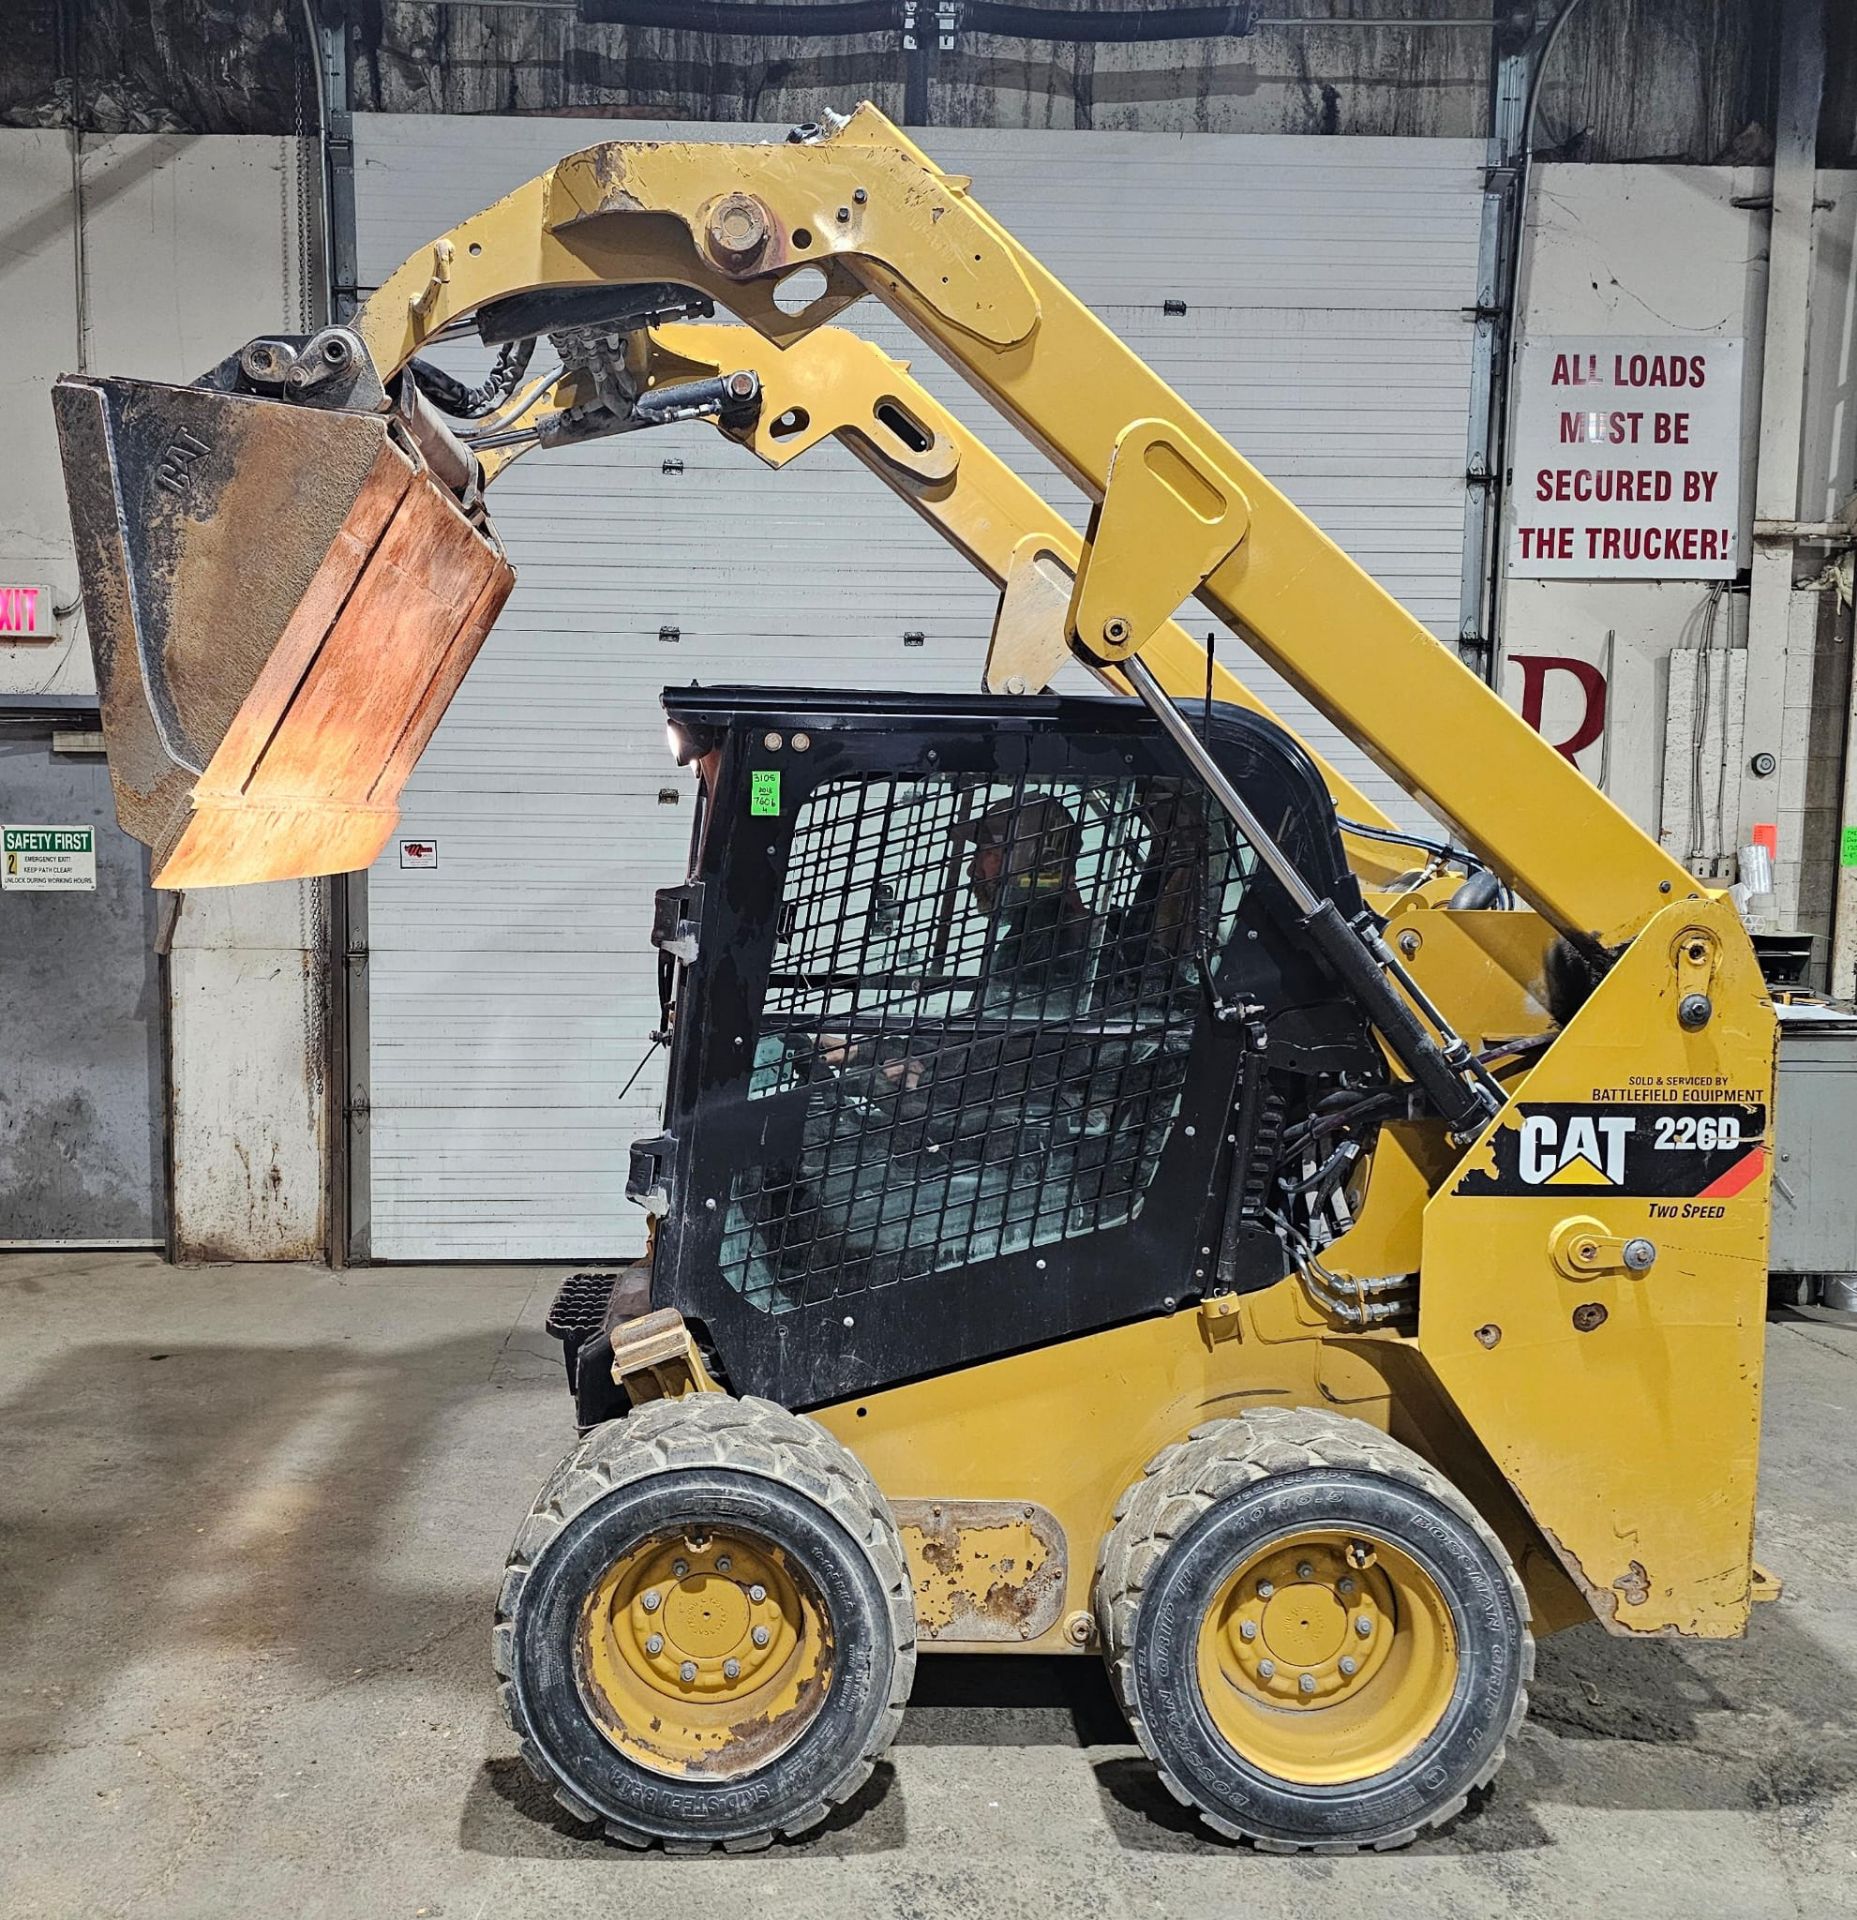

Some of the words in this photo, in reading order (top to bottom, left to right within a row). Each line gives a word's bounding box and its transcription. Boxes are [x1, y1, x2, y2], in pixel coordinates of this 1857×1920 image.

[1551, 354, 1603, 386] ALL
[1614, 355, 1706, 388] LOADS
[1560, 411, 1644, 444] MUST
[1654, 412, 1690, 444] BE
[158, 426, 211, 496] CAT
[1536, 469, 1672, 502] SECURED
[1683, 471, 1719, 502] BY
[1518, 527, 1575, 560] THE
[1585, 527, 1729, 560] TRUCKER!
[6, 832, 52, 850] SAFETY
[54, 833, 89, 850] FIRST
[8, 854, 16, 875] 2
[1592, 1089, 1678, 1102] BATTLEFIELD
[1682, 1089, 1764, 1102] EQUIPMENT
[1629, 1076, 1654, 1086] SOLD
[1656, 1076, 1663, 1085] &
[1667, 1076, 1712, 1086] SERVICED
[1715, 1077, 1728, 1086] BY
[1519, 1115, 1636, 1185] CAT
[1653, 1116, 1740, 1150] 226D
[1410, 1514, 1501, 1632] BOSSMAN
[1160, 1689, 1249, 1807] BOSSMAN
